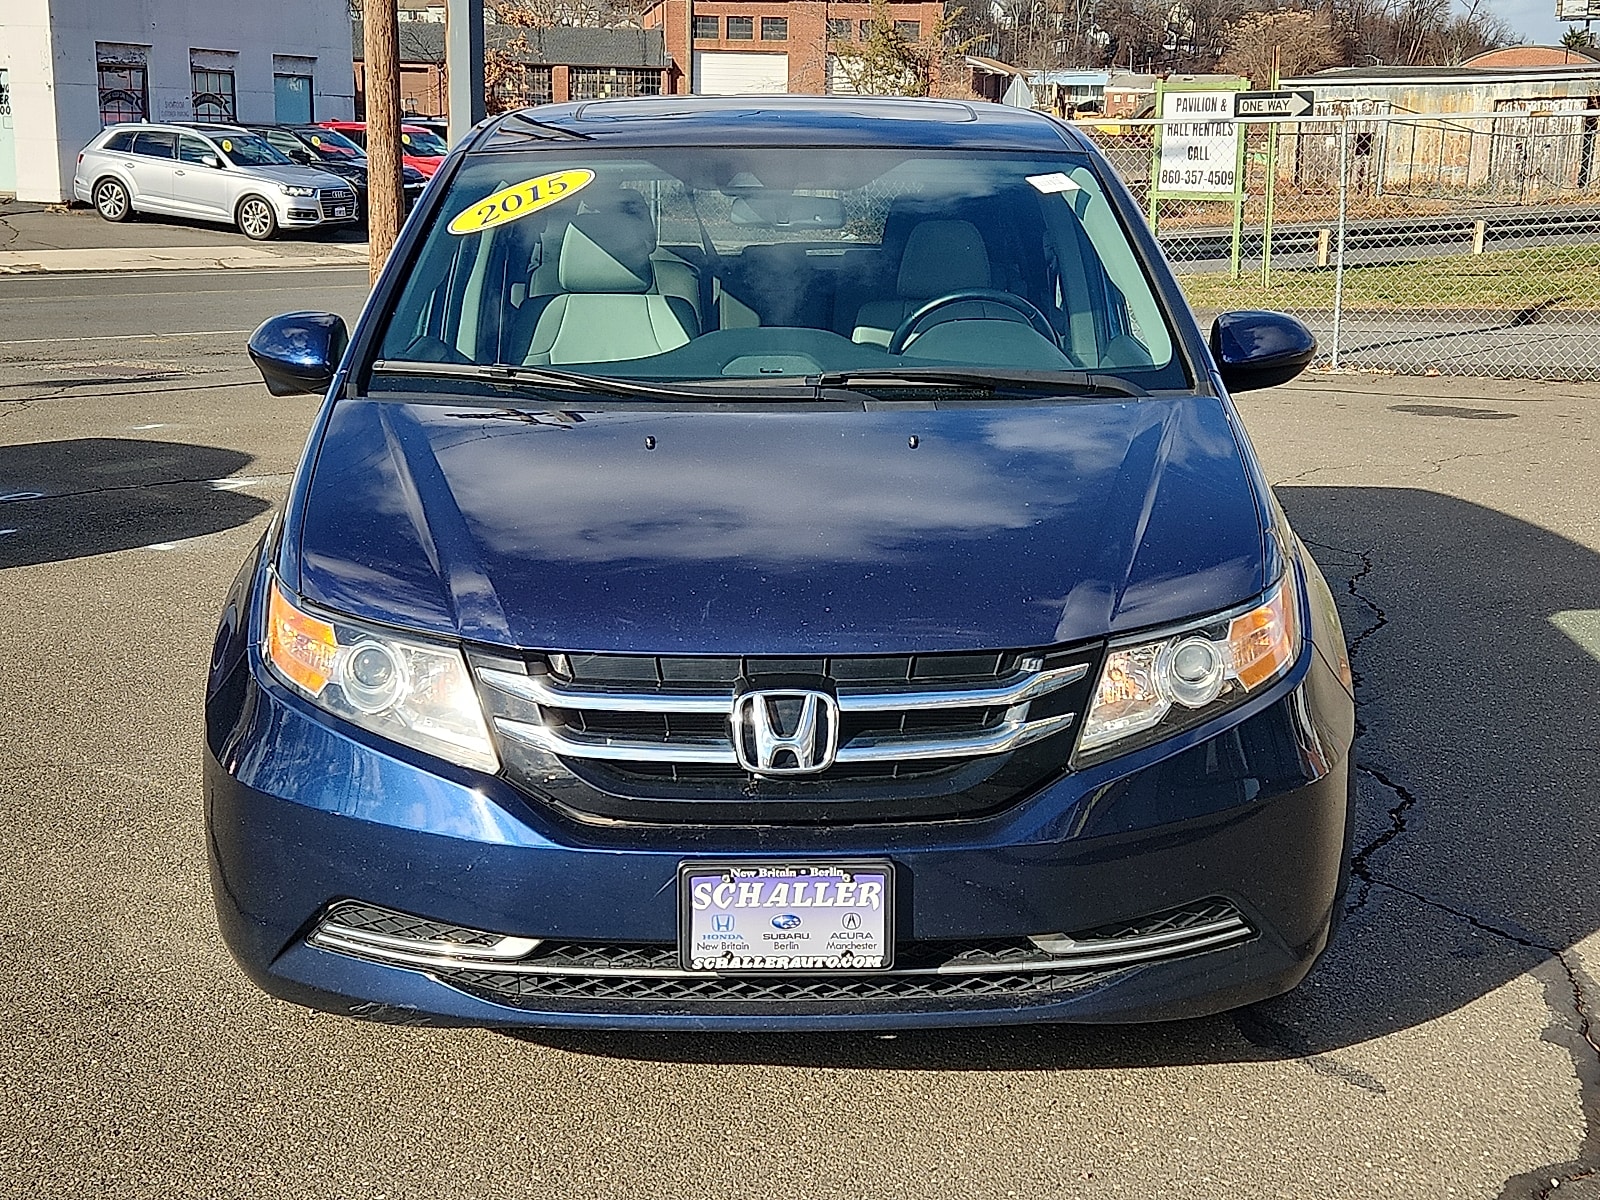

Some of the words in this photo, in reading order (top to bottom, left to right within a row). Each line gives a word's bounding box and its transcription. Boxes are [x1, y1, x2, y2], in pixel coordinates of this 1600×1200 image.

[1176, 96, 1218, 113] PAVILION
[1220, 98, 1228, 112] &
[1242, 100, 1264, 112] ONE
[1267, 99, 1290, 111] WAY
[1167, 123, 1190, 137] HALL
[1192, 123, 1234, 137] RENTALS
[1187, 145, 1210, 161] CALL
[1161, 169, 1234, 186] 860-357-4509
[477, 175, 568, 226] 2015
[730, 868, 757, 878] New
[758, 866, 797, 878] Britain
[810, 867, 844, 878] Berlin
[693, 881, 882, 911] SCHALLER
[830, 932, 874, 940] ACURA
[697, 942, 719, 950] New
[721, 941, 750, 951] Britain
[774, 941, 800, 950] Berlin
[826, 941, 878, 950] Manchester
[692, 955, 884, 970] SCHALLERAUTO.COM
